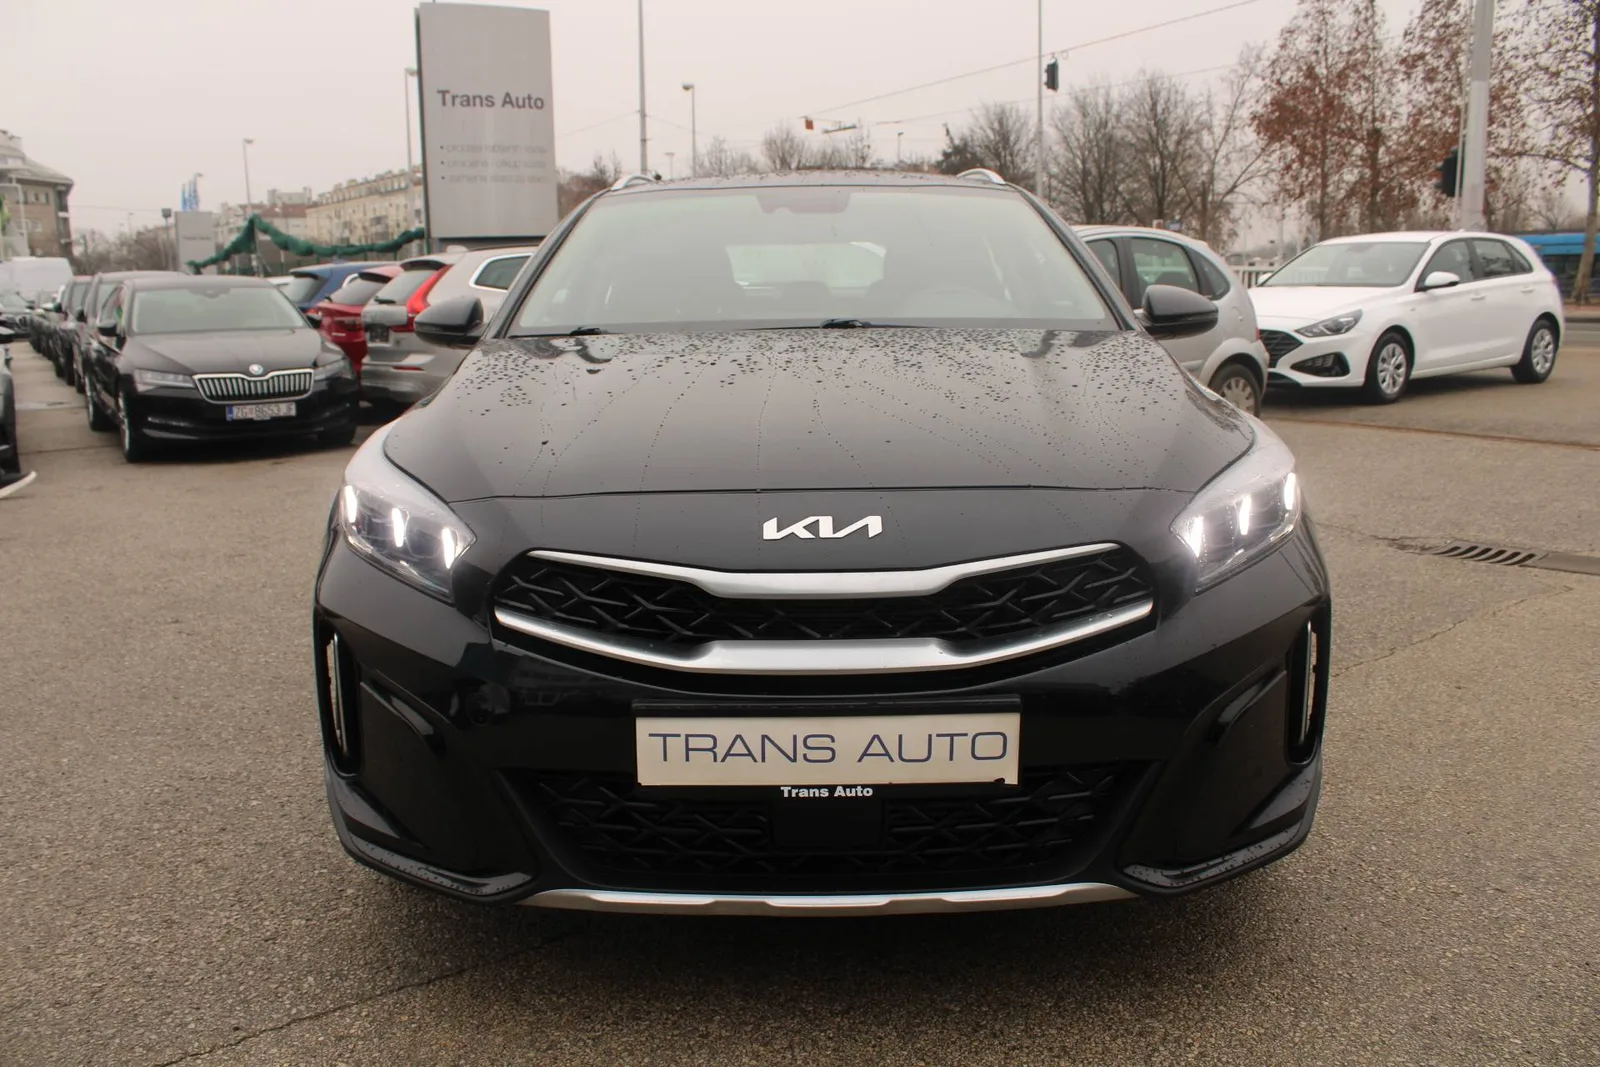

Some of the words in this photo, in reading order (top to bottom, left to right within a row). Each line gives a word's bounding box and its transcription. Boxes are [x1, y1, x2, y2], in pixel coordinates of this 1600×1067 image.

[436, 89, 496, 108] Trans
[501, 91, 545, 110] Auto
[763, 515, 883, 540] KIA
[648, 732, 836, 763] TRANS
[856, 731, 1008, 763] AUTO
[780, 786, 830, 798] Trans
[833, 785, 874, 797] Auto
